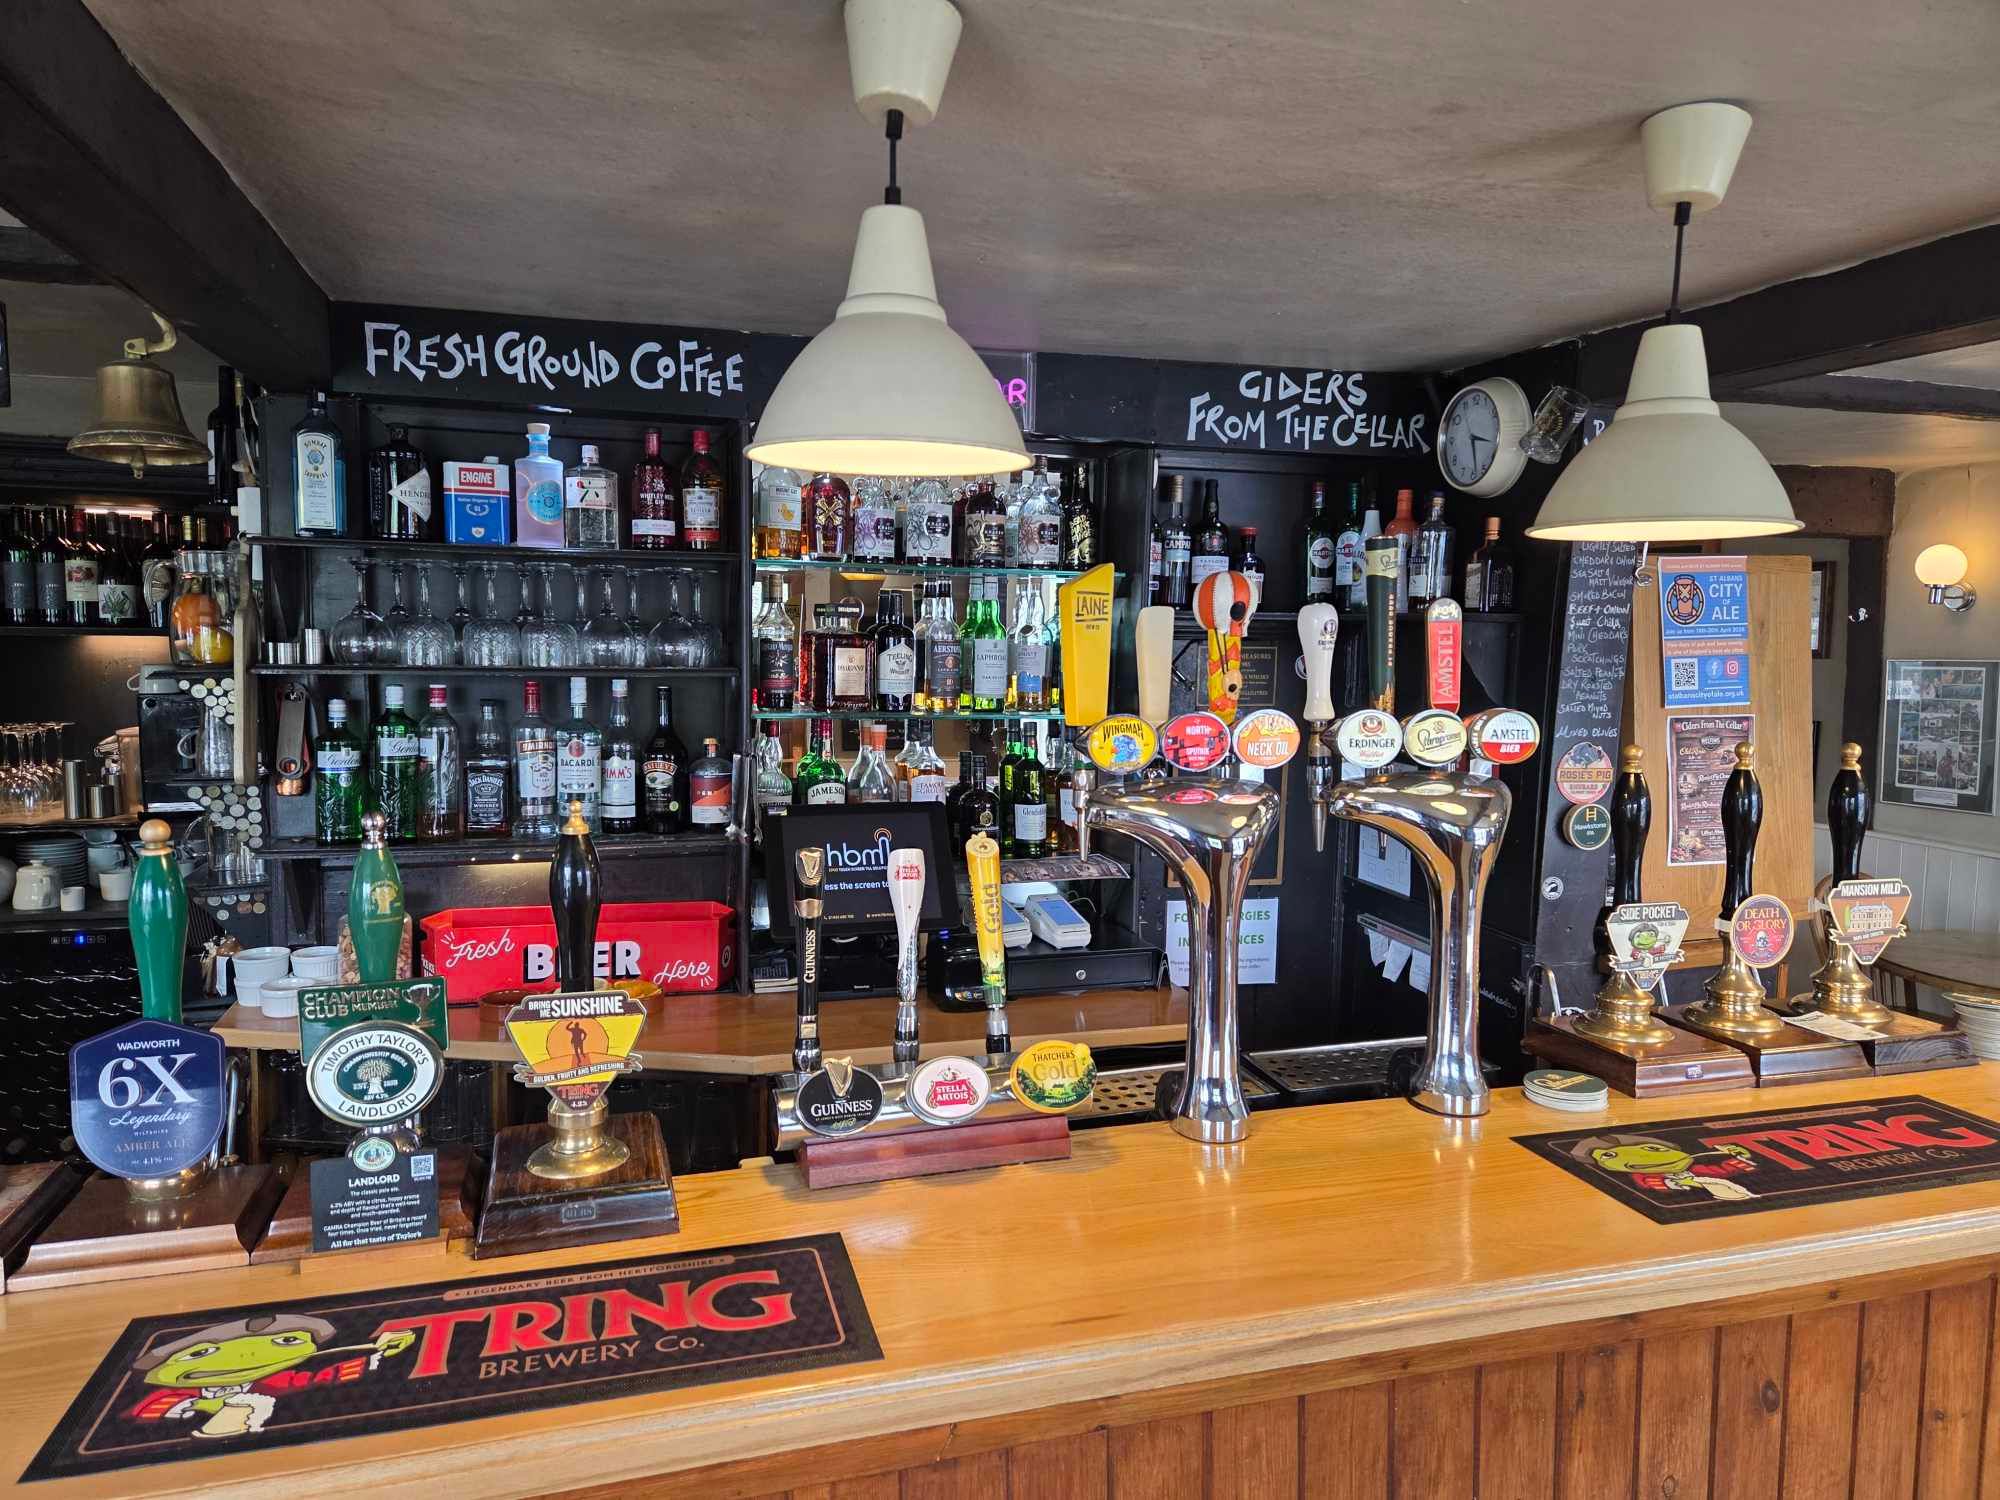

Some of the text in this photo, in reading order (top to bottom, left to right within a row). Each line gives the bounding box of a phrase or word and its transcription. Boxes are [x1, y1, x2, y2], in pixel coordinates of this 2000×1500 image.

[364, 321, 744, 397] FRESH GROUND COFFEE
[1237, 369, 1369, 418] CIDERS
[1186, 392, 1433, 455] FROM THE CELLAR
[461, 471, 493, 484] ENGINE
[1709, 584, 1742, 598] CITY
[1075, 598, 1110, 617] LAINE
[1712, 606, 1740, 620] ALE
[1438, 624, 1456, 698] AMSTEL
[1103, 722, 1144, 742] WINGMAN
[1186, 726, 1210, 736] NORTH
[1592, 726, 1618, 738] OLIVES
[1682, 720, 1744, 730] Ciders From The Cellar
[1492, 728, 1529, 740] AMSTEL
[1247, 741, 1289, 756] NECK OIL
[1348, 738, 1396, 748] ERDINGER
[1500, 744, 1520, 753] BIER
[560, 758, 595, 767] BACARDI
[602, 766, 632, 780] PIMM'S
[1560, 770, 1611, 780] ROSIE'S PIG
[840, 882, 853, 890] the
[1841, 882, 1900, 897] MANSION MILD
[982, 883, 1000, 934] Gold
[1620, 906, 1677, 920] SIDE POCKET
[1744, 908, 1780, 919] DEATH
[1736, 919, 1787, 931] OR GLORY
[446, 928, 515, 968] Fresh
[803, 928, 816, 984] GUINNESS
[525, 940, 641, 982] BER
[654, 959, 710, 985] Here
[304, 988, 400, 1006] CHAMPION
[304, 1000, 400, 1020] CLUB MEMBER
[529, 1001, 551, 1011] BRING
[540, 1010, 551, 1018] ME
[551, 996, 624, 1018] SUNSHINE
[117, 1038, 180, 1051] WADWORTH
[321, 1033, 429, 1072] TIMOTHY TAYLOR'S
[1032, 1051, 1075, 1062] THATCHERS
[578, 1067, 590, 1076] AND
[1033, 1060, 1080, 1081] Gold
[98, 1052, 199, 1108] 6X
[936, 1084, 968, 1094] STELLA
[936, 1092, 969, 1101] ARTOIS
[338, 1092, 417, 1118] LANDLORD
[810, 1100, 872, 1117] GUINNESS
[108, 1108, 192, 1130] Legendary
[114, 1137, 190, 1153] AMBER ALE
[1698, 1114, 1999, 1171] TRING
[1830, 1148, 1967, 1172] BREWERY Co.
[348, 1174, 400, 1187] LANDLORD
[331, 1240, 342, 1248] All
[369, 1235, 386, 1243] taste
[395, 1231, 422, 1240] Taylor's
[466, 1258, 714, 1296] LEGENDARY BEER FROM HERTFORDSHIRE
[375, 1270, 797, 1380] TRING
[478, 1333, 706, 1380] BREWERY Co.
